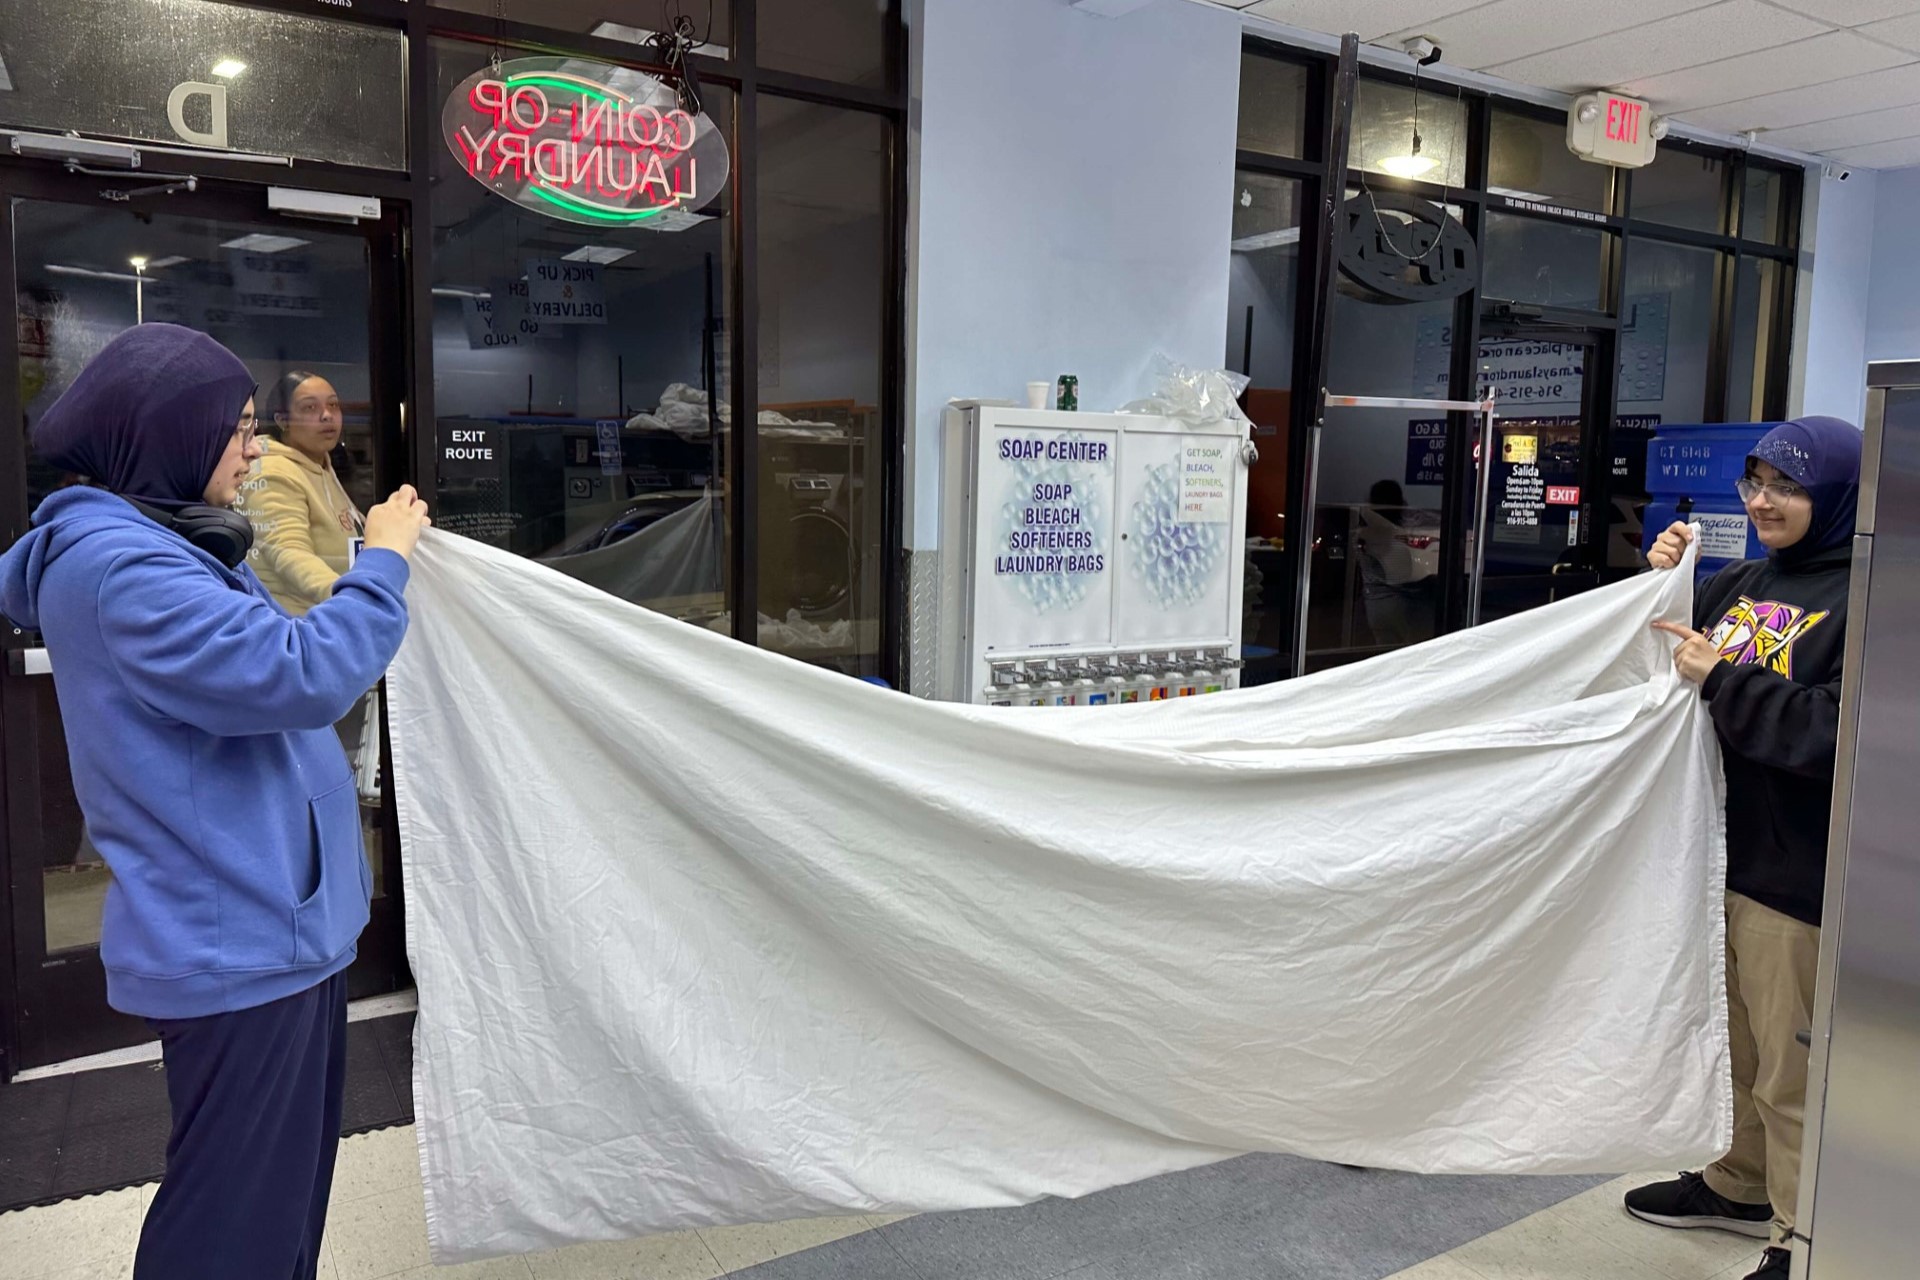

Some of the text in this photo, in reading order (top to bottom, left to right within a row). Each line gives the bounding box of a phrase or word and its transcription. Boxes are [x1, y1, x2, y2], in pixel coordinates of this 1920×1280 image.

[1606, 98, 1642, 144] EXIT
[452, 430, 486, 443] EXIT
[445, 448, 493, 460] ROUTE
[1000, 438, 1108, 462] SOAP CENTER
[1186, 448, 1223, 459] GET SOAP,
[1614, 457, 1627, 465] EXIT
[1186, 463, 1215, 474] BLEACH,
[1512, 465, 1540, 477] Salida
[1612, 467, 1629, 476] ROUTE
[1185, 478, 1224, 488] SOFTENERS,
[1033, 483, 1073, 502] SOAP
[1184, 490, 1208, 498] LAUNDRY
[1549, 488, 1578, 502] EXIT
[1184, 503, 1203, 512] HERE
[1024, 507, 1081, 526] BLEACH
[1010, 530, 1093, 550] SOFTENERS
[996, 554, 1105, 575] LAUNDRY BAGS
